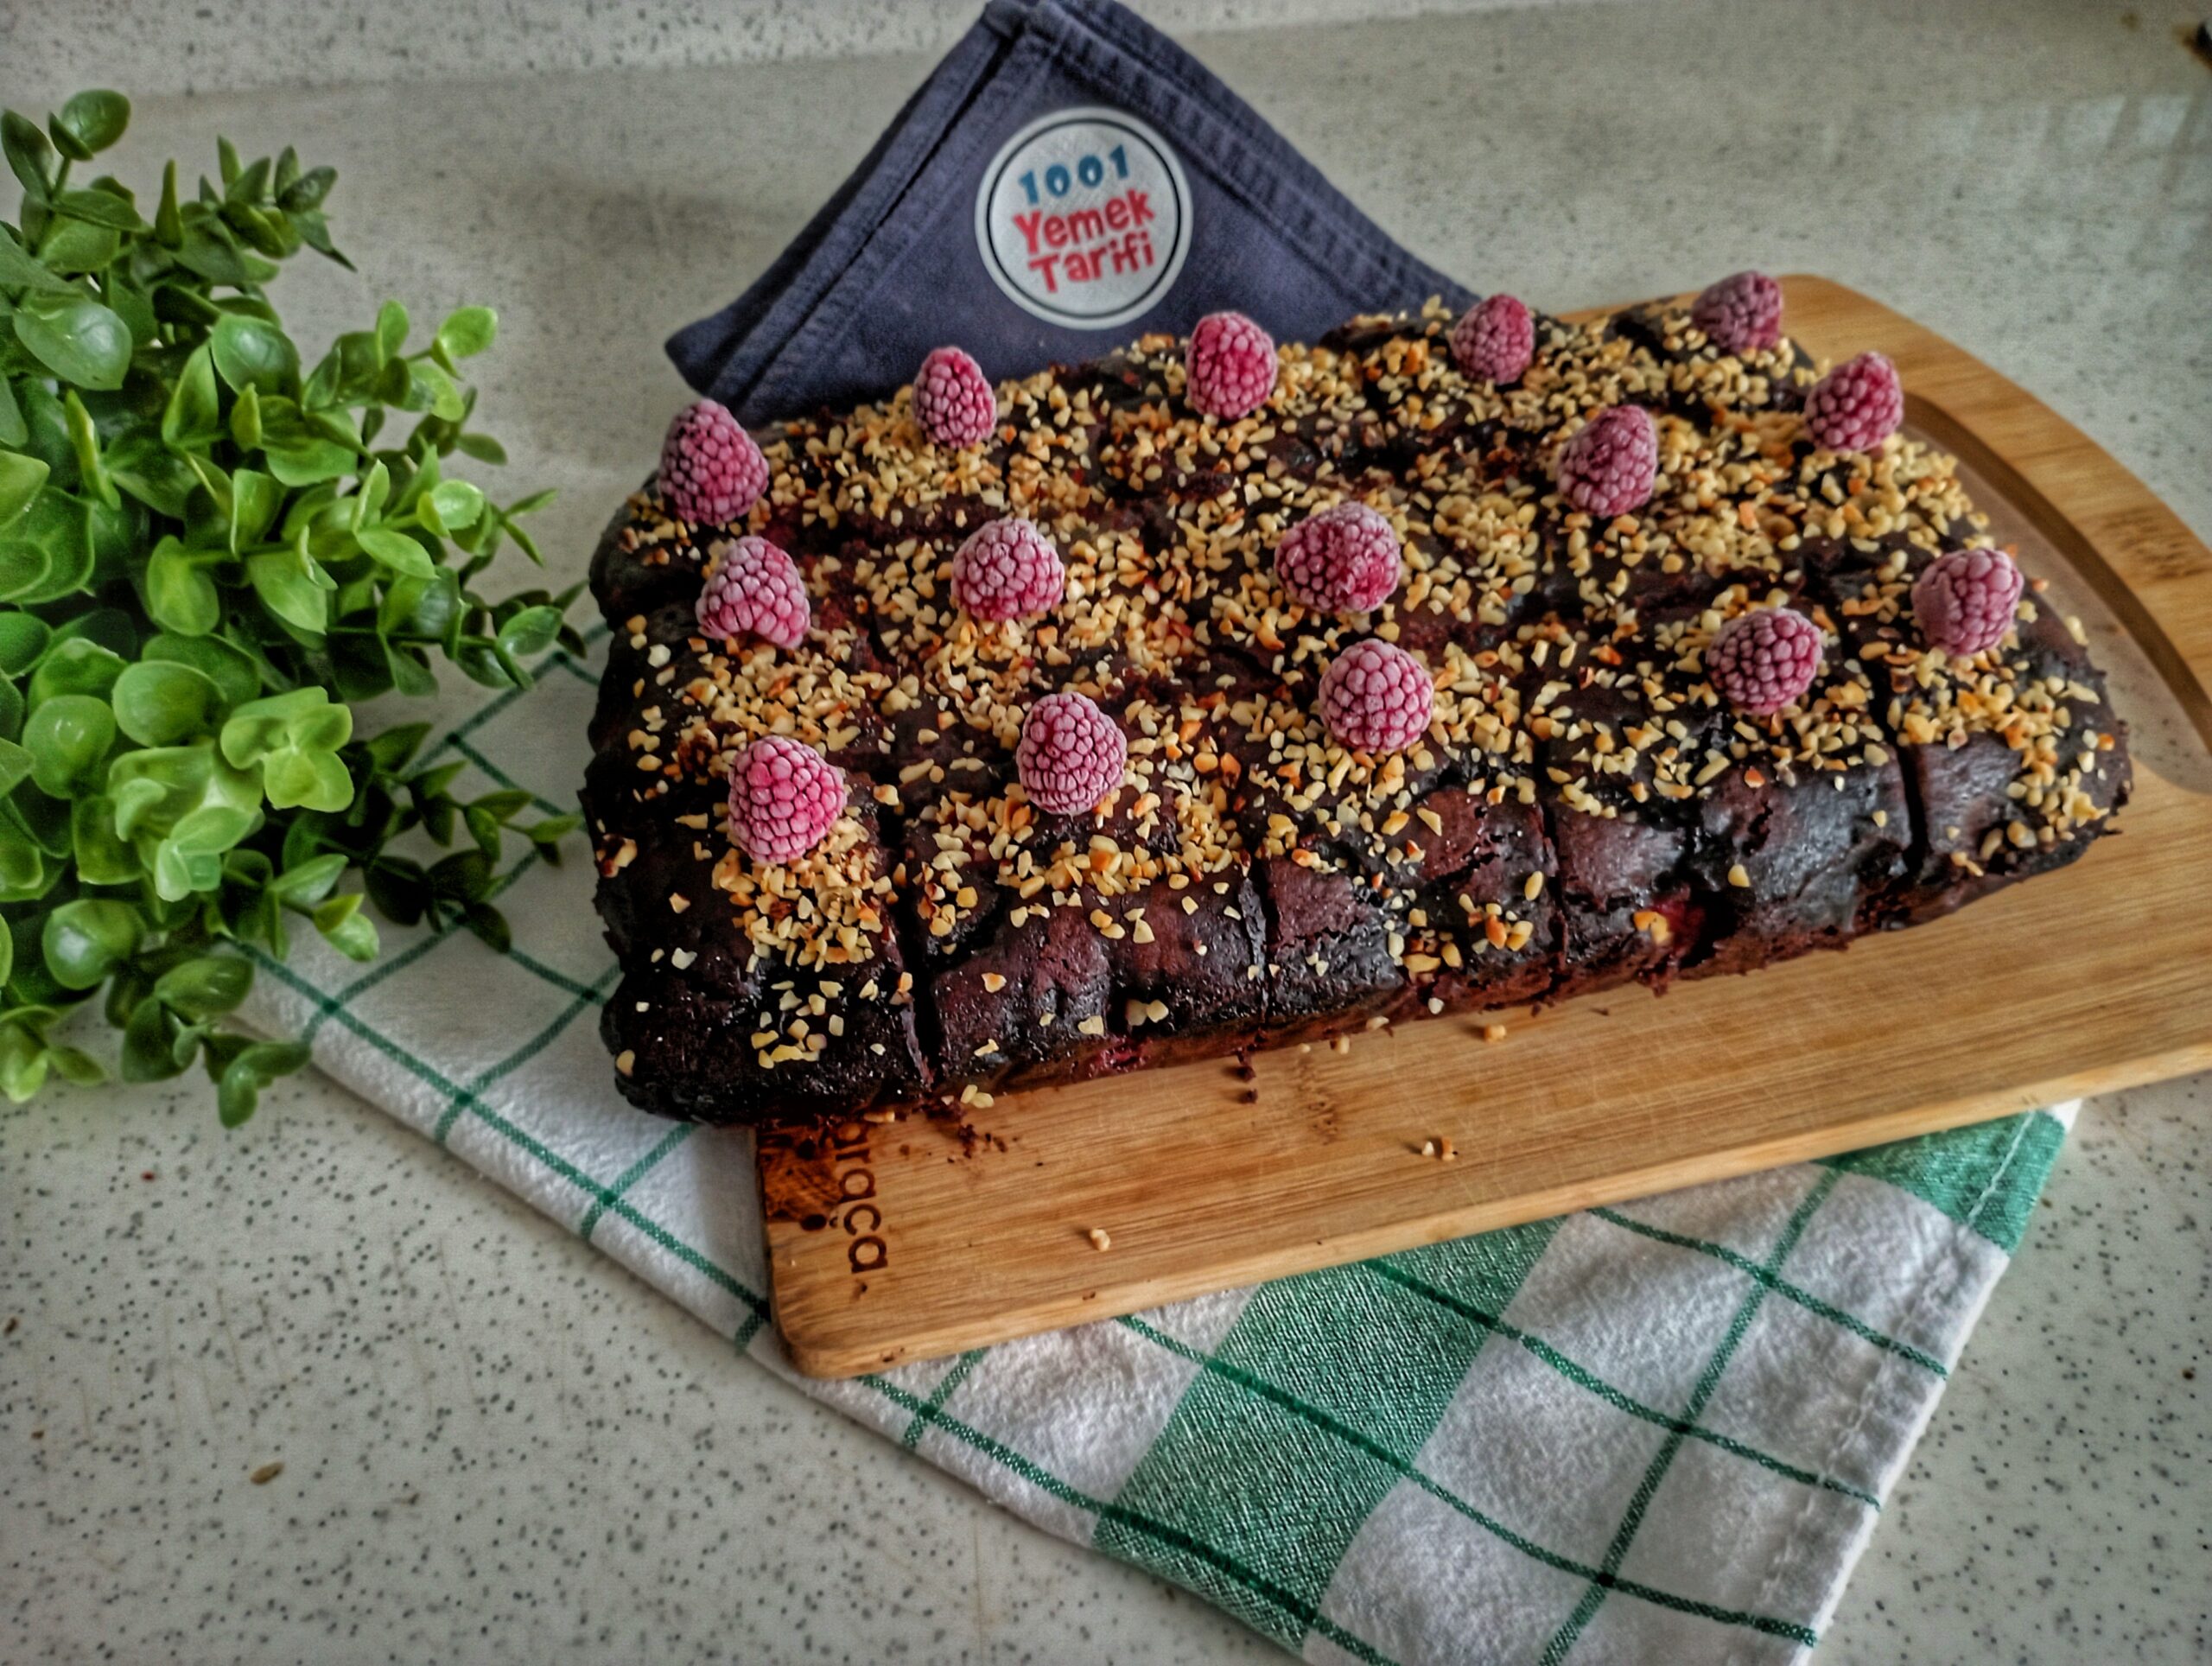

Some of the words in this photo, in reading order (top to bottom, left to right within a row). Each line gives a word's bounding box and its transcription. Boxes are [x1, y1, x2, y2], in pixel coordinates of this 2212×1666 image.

[1018, 144, 1128, 205] 1001
[1013, 188, 1155, 256] Yemek
[1027, 230, 1154, 294] Tarifi
